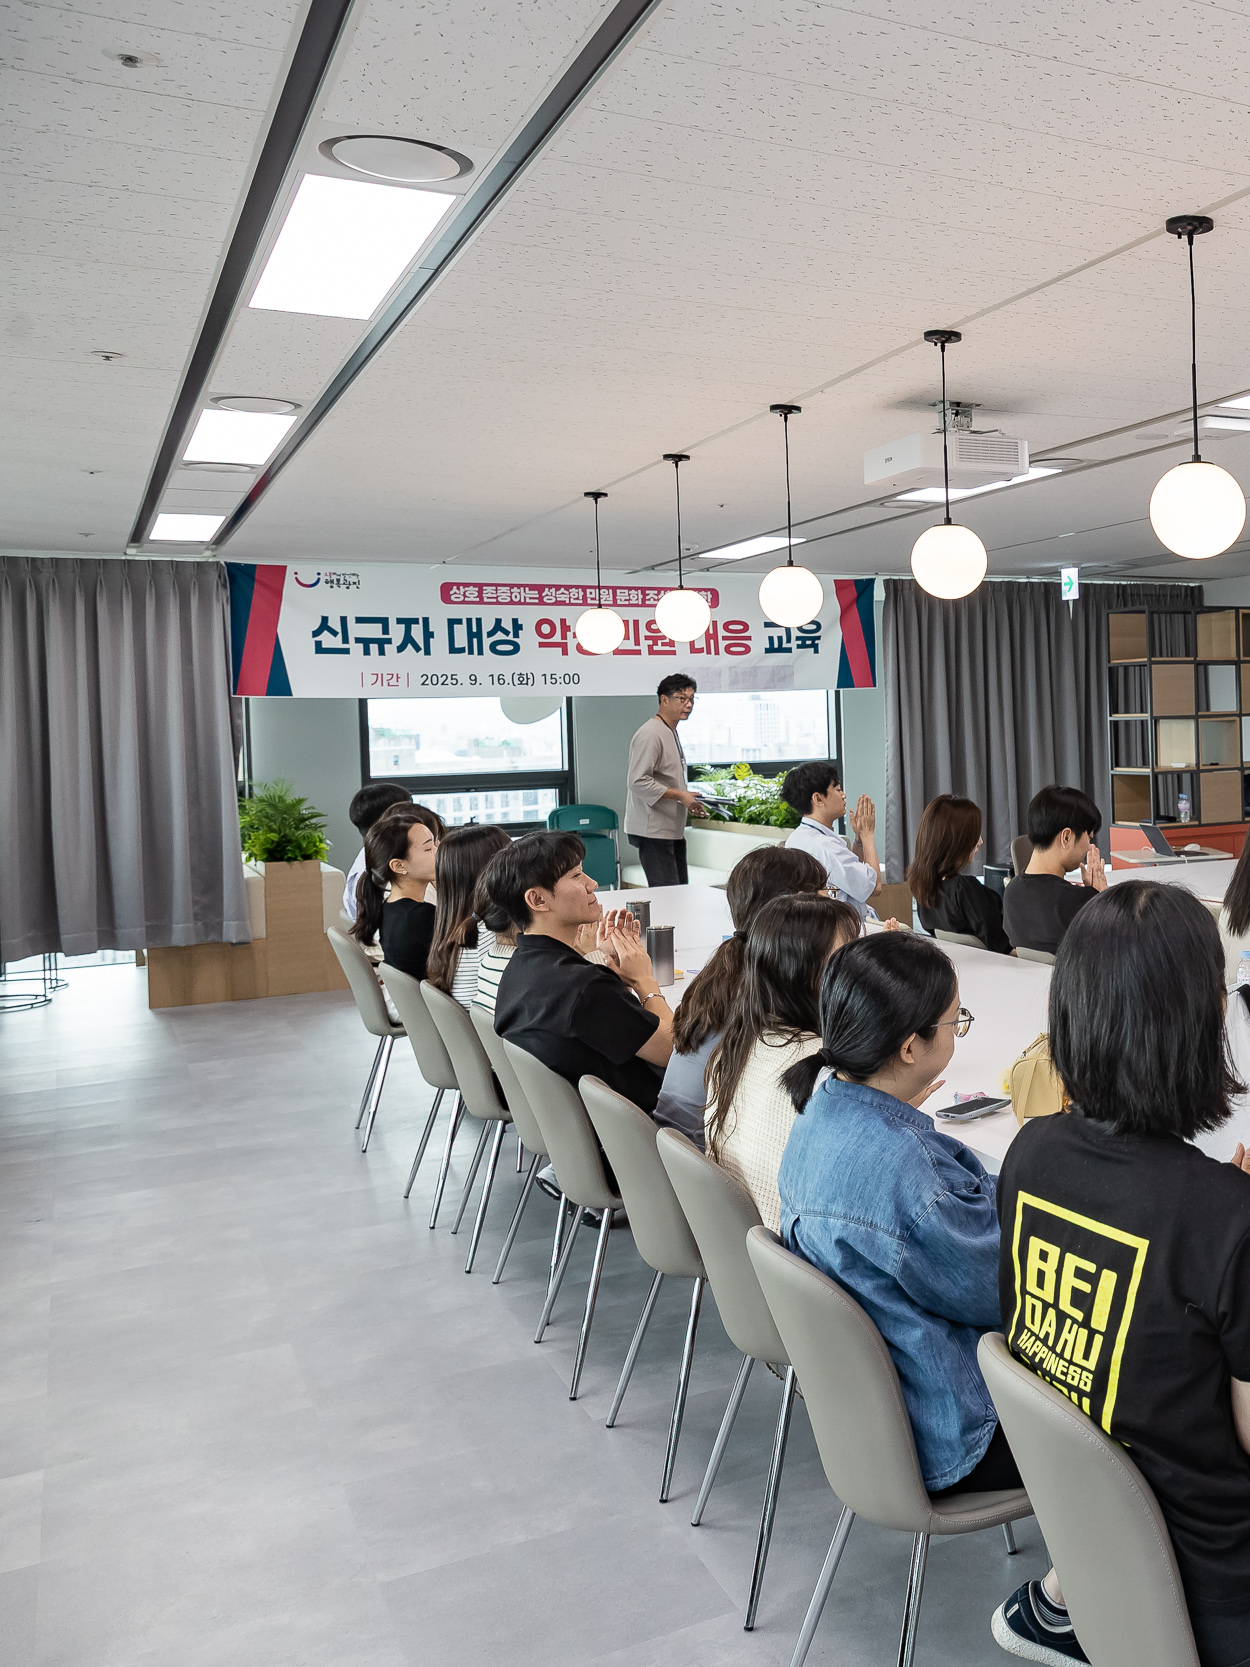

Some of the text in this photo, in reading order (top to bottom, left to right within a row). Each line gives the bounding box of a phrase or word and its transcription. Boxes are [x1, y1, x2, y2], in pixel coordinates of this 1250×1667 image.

[449, 585, 480, 602] 상호
[482, 586, 539, 603] 존중하는
[542, 587, 583, 604] 성숙한
[586, 588, 613, 605] 민원
[616, 589, 643, 605] 문화
[310, 615, 435, 656] 신규자
[446, 616, 523, 657] 대상
[763, 619, 822, 655] 교육
[420, 671, 580, 688] 2025. 9. 16.(화) 15:00
[1025, 1235, 1118, 1333] BEI
[1017, 1328, 1094, 1393] HAPPINESS
